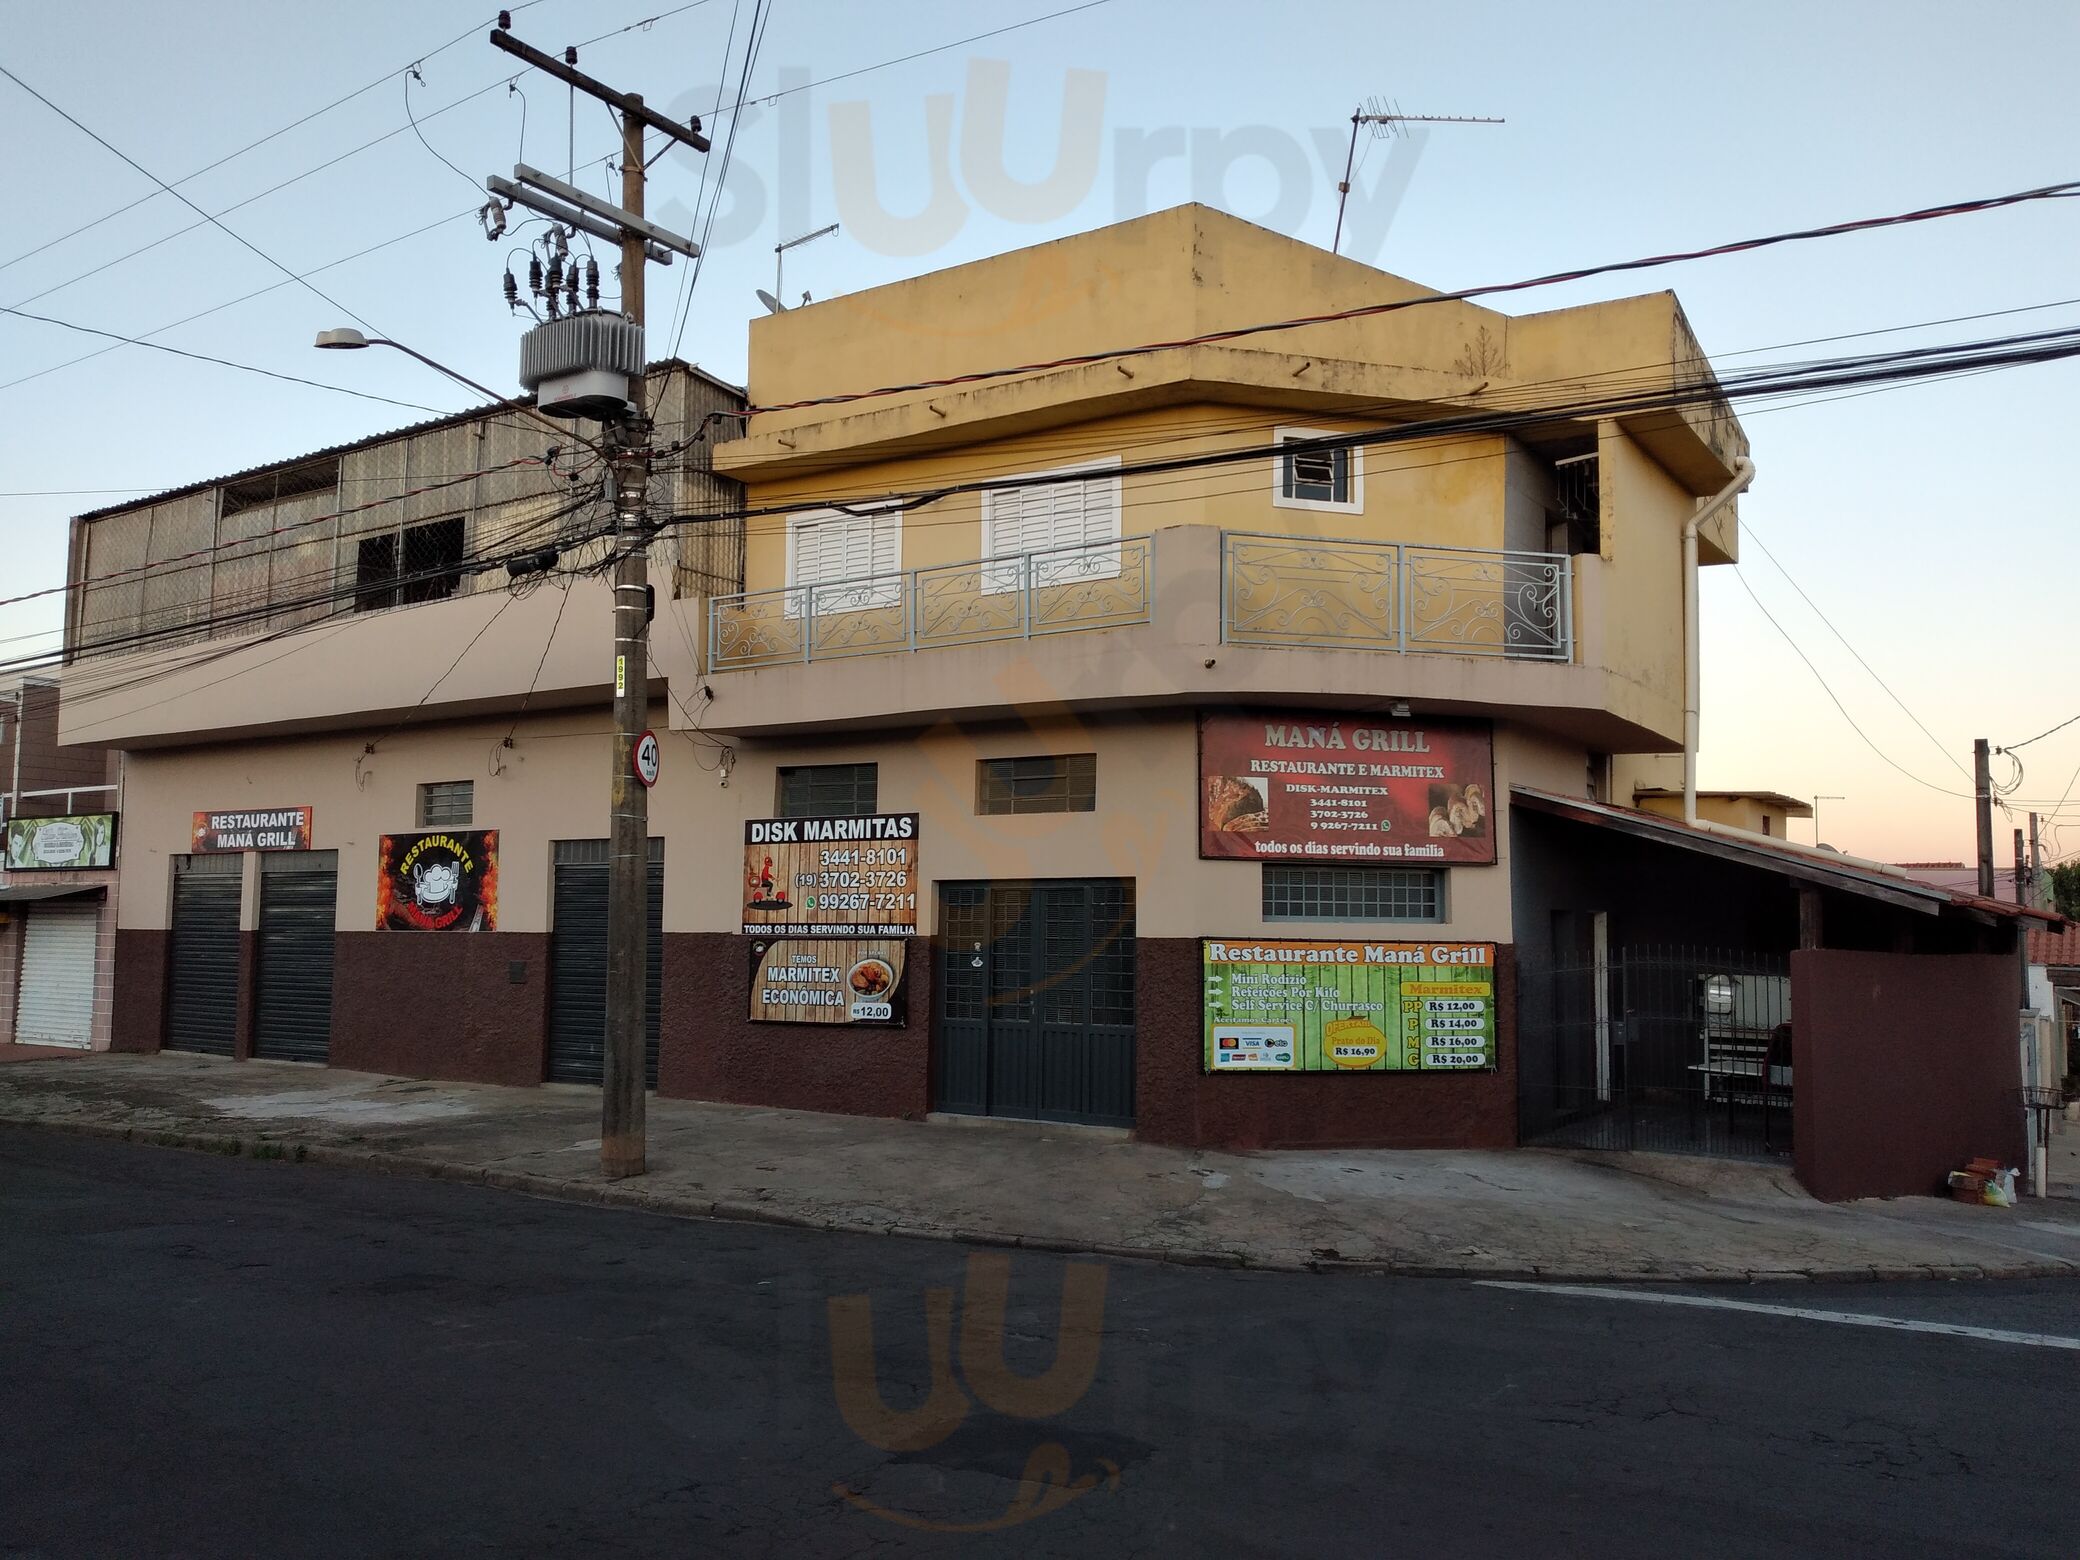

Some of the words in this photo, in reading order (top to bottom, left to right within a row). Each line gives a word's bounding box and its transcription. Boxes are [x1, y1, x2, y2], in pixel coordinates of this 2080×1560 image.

[1265, 722, 1346, 750] MANÁ
[1352, 728, 1430, 752] GRILL
[642, 745, 657, 767] 40
[1250, 760, 1355, 776] RESTAURANTE
[1358, 764, 1367, 775] E
[1370, 764, 1444, 779] MARMITEX
[1286, 784, 1388, 796] DISK-MARMITEX
[1310, 799, 1367, 808] 3441-8101
[212, 811, 304, 830] RESTAURANTE
[1310, 810, 1368, 819] 3702-3726
[751, 821, 798, 843] DISK
[804, 817, 912, 841] MARMITAS
[1310, 822, 1318, 830] 9
[1320, 822, 1378, 831] 9267-7211
[217, 830, 253, 848] MANÁ
[257, 832, 295, 847] GRILL
[400, 835, 474, 875] RESTAURANTE
[1255, 841, 1287, 854] todos
[1289, 844, 1302, 854] os
[1305, 842, 1328, 855] dias
[1330, 843, 1381, 856] servindo
[1383, 846, 1402, 857] sua
[820, 848, 906, 866] 3441-8101
[795, 873, 817, 888] (19)
[819, 871, 907, 888] 3702-3726
[818, 893, 916, 910] 99267-7211
[744, 925, 772, 934] TODOS
[774, 925, 786, 934] OS
[788, 925, 808, 934] DIAS
[810, 925, 855, 934] SERVINDO
[857, 925, 876, 934] SUA
[791, 955, 817, 964] TEMOS
[1209, 943, 1359, 963] Restaurante
[1364, 946, 1426, 963] Maná
[1431, 946, 1486, 964] Grill
[767, 967, 841, 983] MARMITEX
[1231, 973, 1258, 985] Mini
[1291, 987, 1312, 998] Por
[1314, 987, 1340, 998] Kilo
[1409, 984, 1482, 994] Marmitex
[762, 986, 844, 1006] ECONÔMICA
[1231, 1000, 1255, 1011] Self
[1258, 1000, 1303, 1011] Service
[1305, 1000, 1318, 1012] C/
[1322, 1000, 1383, 1012] Churrasco
[1403, 1001, 1423, 1013] PP
[1429, 1002, 1444, 1012] R$
[1447, 1002, 1475, 1011] 12,00
[860, 1007, 889, 1018] 12,00
[1408, 1018, 1419, 1030] P
[1431, 1020, 1446, 1029] R$
[1449, 1020, 1477, 1029] 14,00
[1331, 1037, 1353, 1045] Prato
[1355, 1037, 1366, 1045] do
[1367, 1037, 1380, 1045] Dia
[1407, 1036, 1420, 1049] M
[1431, 1037, 1446, 1046] R$
[1449, 1037, 1477, 1046] 16,00
[1335, 1047, 1348, 1056] R$
[1351, 1047, 1375, 1056] 16,90
[1408, 1054, 1420, 1066] G
[1432, 1055, 1447, 1064] R$
[1450, 1055, 1478, 1064] 20,00
